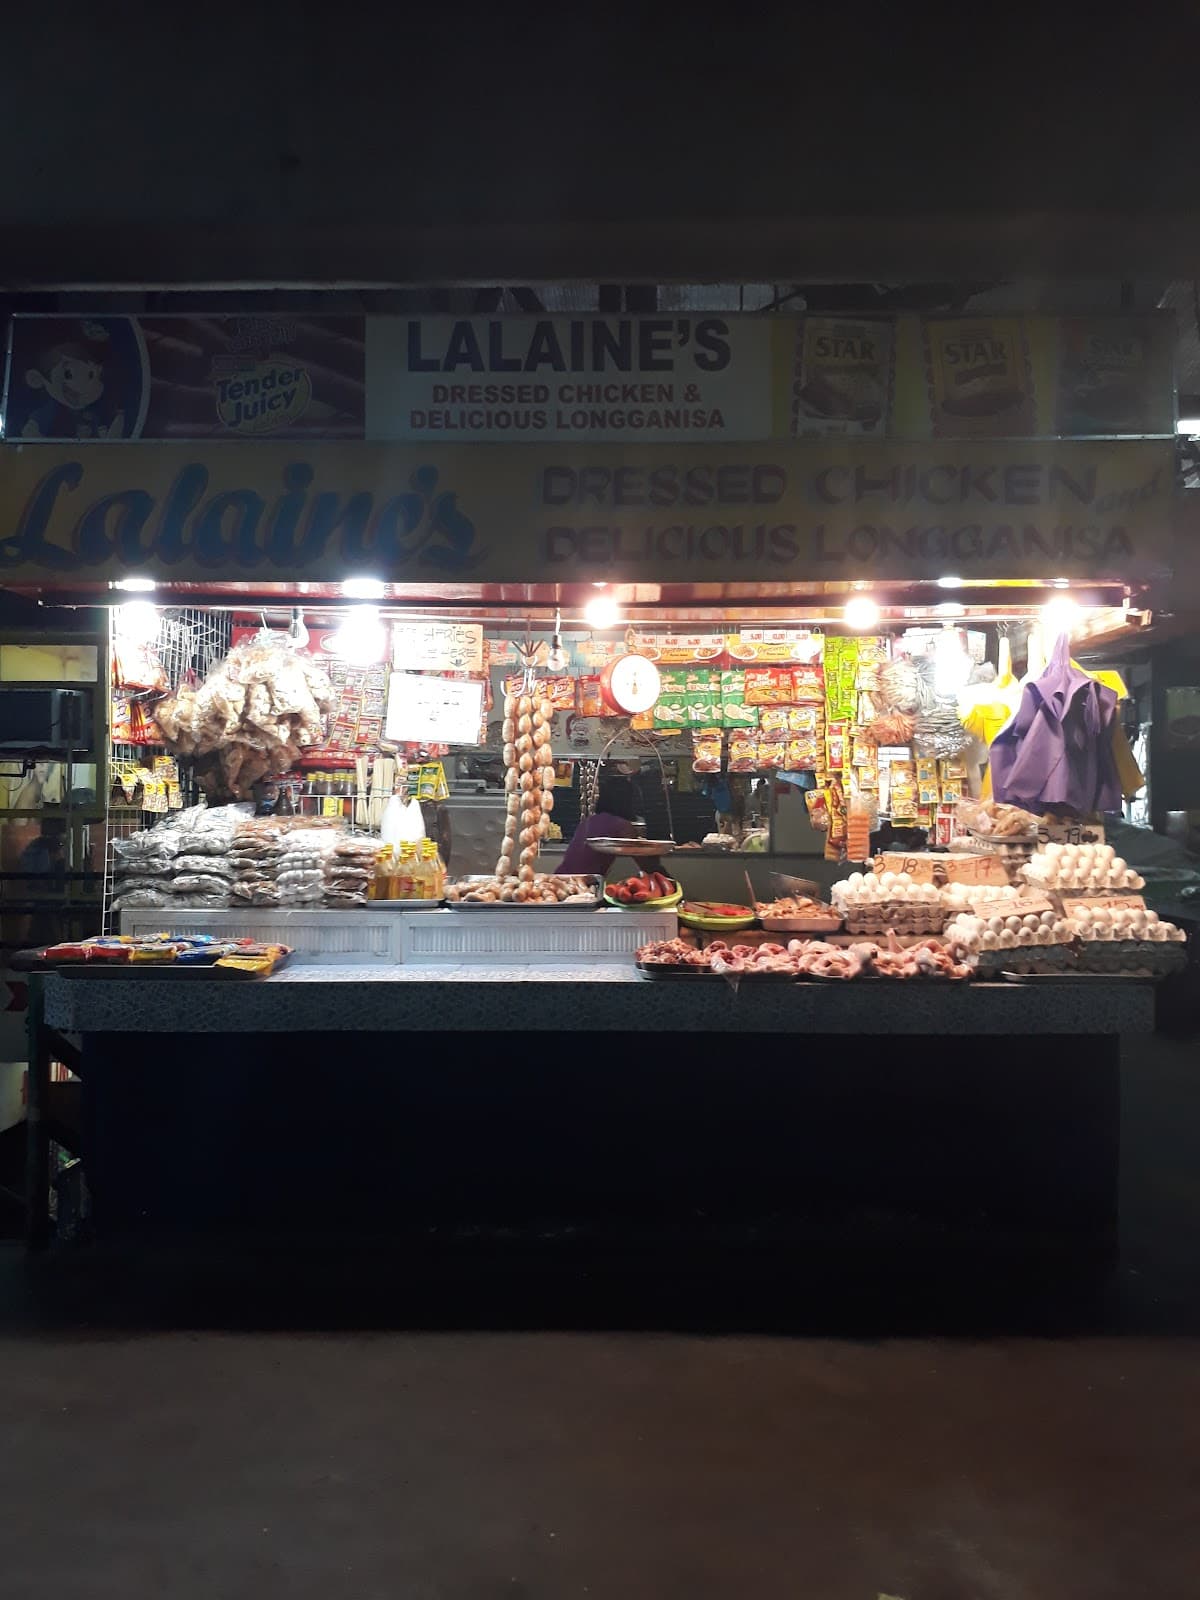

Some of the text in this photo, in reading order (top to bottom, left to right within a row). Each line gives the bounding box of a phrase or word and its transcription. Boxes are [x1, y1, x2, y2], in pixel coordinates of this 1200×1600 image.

[407, 318, 732, 373] LALAINE'S
[814, 335, 876, 361] STAR
[944, 337, 1008, 364] STAR
[215, 367, 305, 404] Tender
[432, 383, 702, 404] DRESSED CHICKEN &
[226, 386, 298, 428] Juicy
[410, 408, 725, 430] DELICIOUS LONGGANISA
[542, 464, 787, 506] DRESSED
[814, 463, 1097, 506] CHICKEN
[0, 461, 484, 569] Lalaine's
[544, 523, 1137, 564] DELICIOUS LONGGANISA
